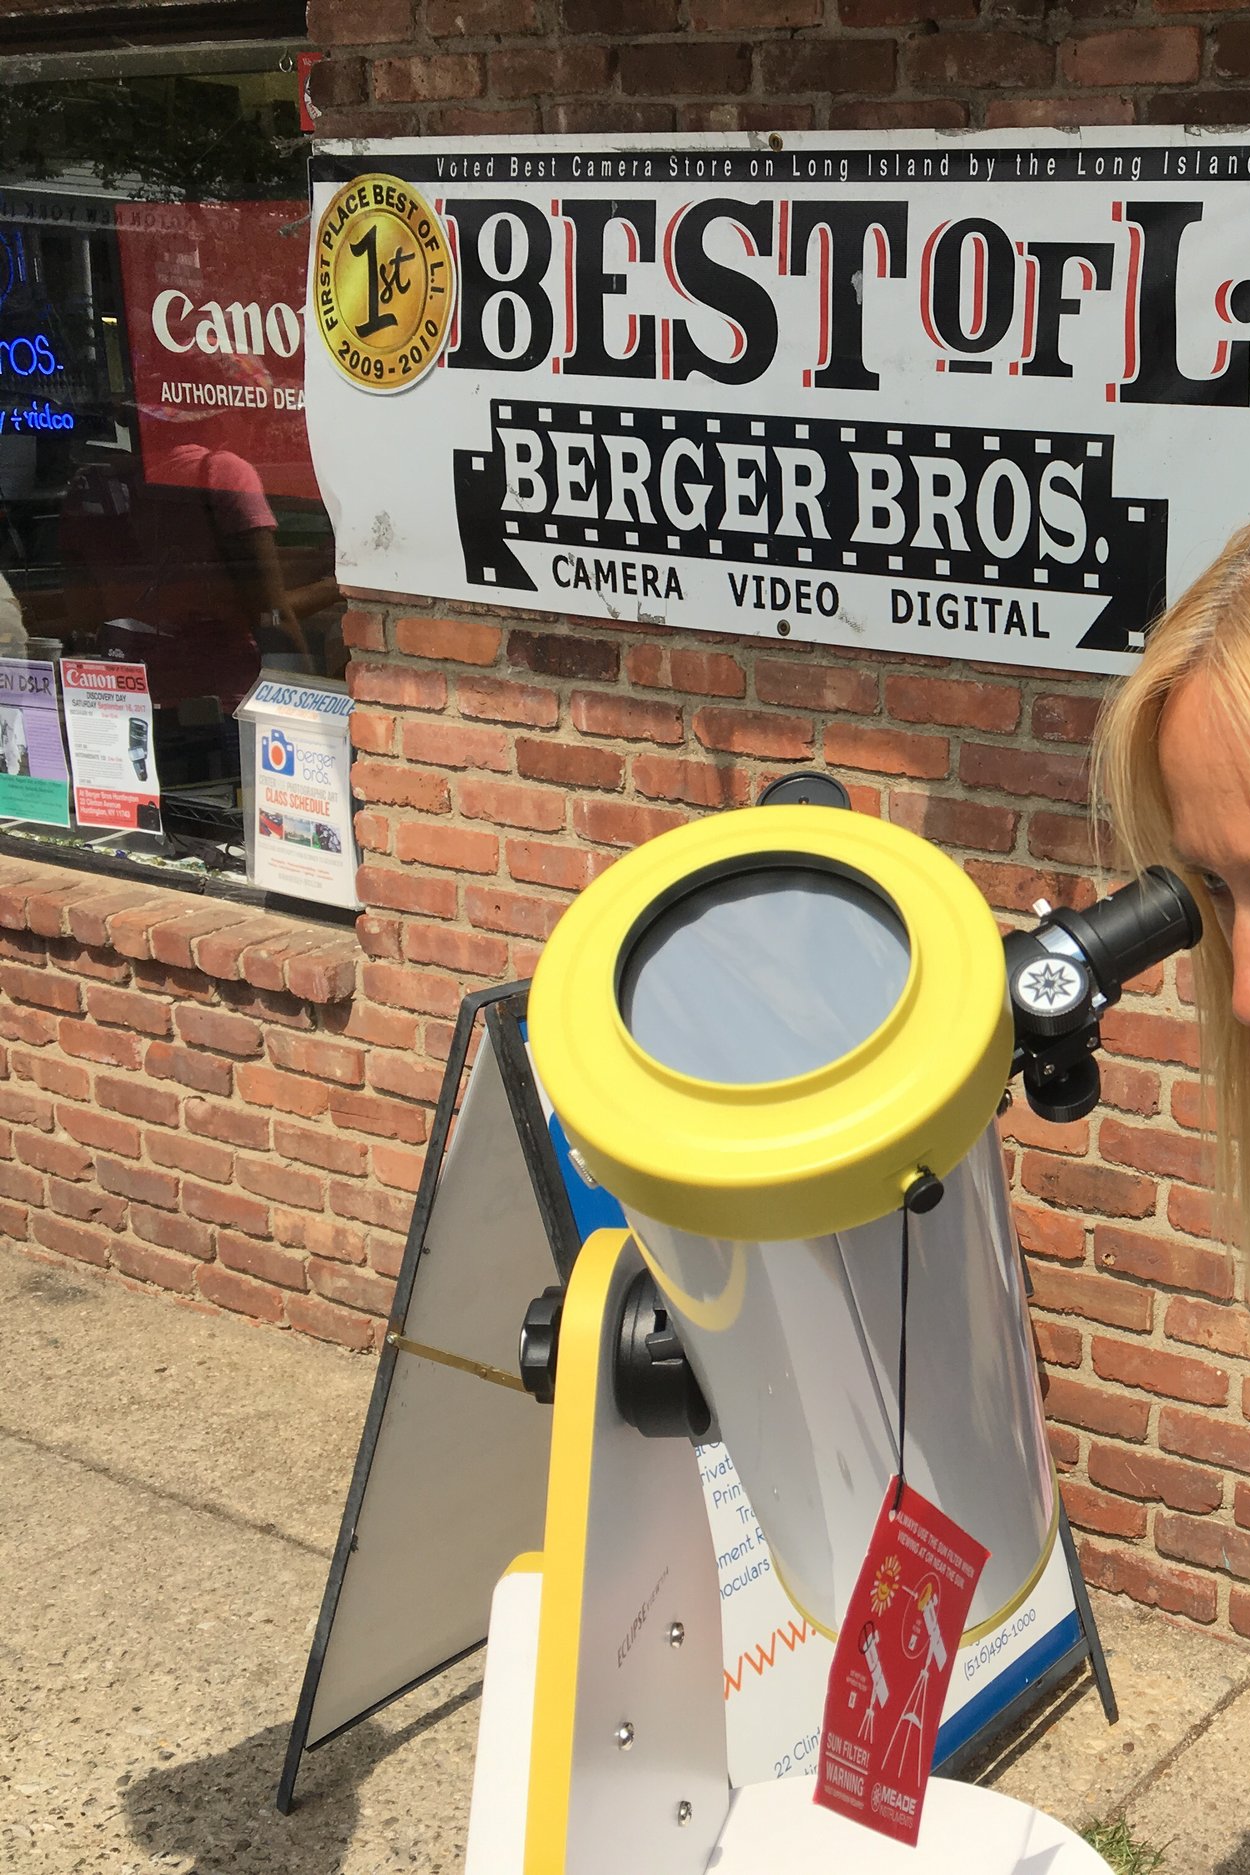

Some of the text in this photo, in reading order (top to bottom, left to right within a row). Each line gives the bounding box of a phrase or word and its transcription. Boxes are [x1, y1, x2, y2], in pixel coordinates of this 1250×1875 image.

[436, 156, 494, 177] Voted
[510, 156, 556, 177] Best
[572, 155, 652, 177] Camera
[669, 154, 732, 177] Store
[750, 158, 774, 177] on
[792, 154, 848, 182] Long
[868, 153, 949, 177] Island
[969, 152, 996, 182] by
[1016, 152, 1056, 176] the
[1077, 152, 1142, 181] Long
[319, 183, 445, 333] FIRST PLACE BEST OF L.I.
[349, 223, 416, 339] 1st
[437, 197, 909, 391] BEST
[921, 216, 1115, 378] OF
[151, 289, 307, 358] Cano
[161, 381, 268, 409] AUTHORIZED
[496, 426, 1110, 566] BERGER BROS.
[551, 554, 1051, 640] CAMERA VIDEO DIGITAL
[19, 674, 53, 696] DSLR
[66, 669, 118, 690] Canon
[117, 675, 146, 691] EOS
[71, 699, 97, 708] SATURDAY
[96, 702, 124, 712] September
[86, 691, 127, 702] DISCOVERY DAY
[255, 684, 298, 707] CLASS
[294, 691, 357, 717] SCHEDULE
[296, 743, 336, 771] berger
[303, 763, 332, 786] bros.
[265, 786, 331, 817] CLASS SCHEDULE
[286, 781, 327, 800] PHOTOGRAPHIC
[712, 1482, 742, 1510] Prin
[896, 1510, 919, 1535] ALWAYS
[716, 1533, 755, 1570] ment
[723, 1618, 817, 1701] www.
[963, 1608, 1036, 1682] (516)496-1000
[826, 1732, 870, 1769] SUN FILTER!
[773, 1755, 793, 1779] 22
[825, 1760, 865, 1797] WARNING
[879, 1803, 914, 1829] INSTRUMENTS
[880, 1785, 918, 1816] MEADE
